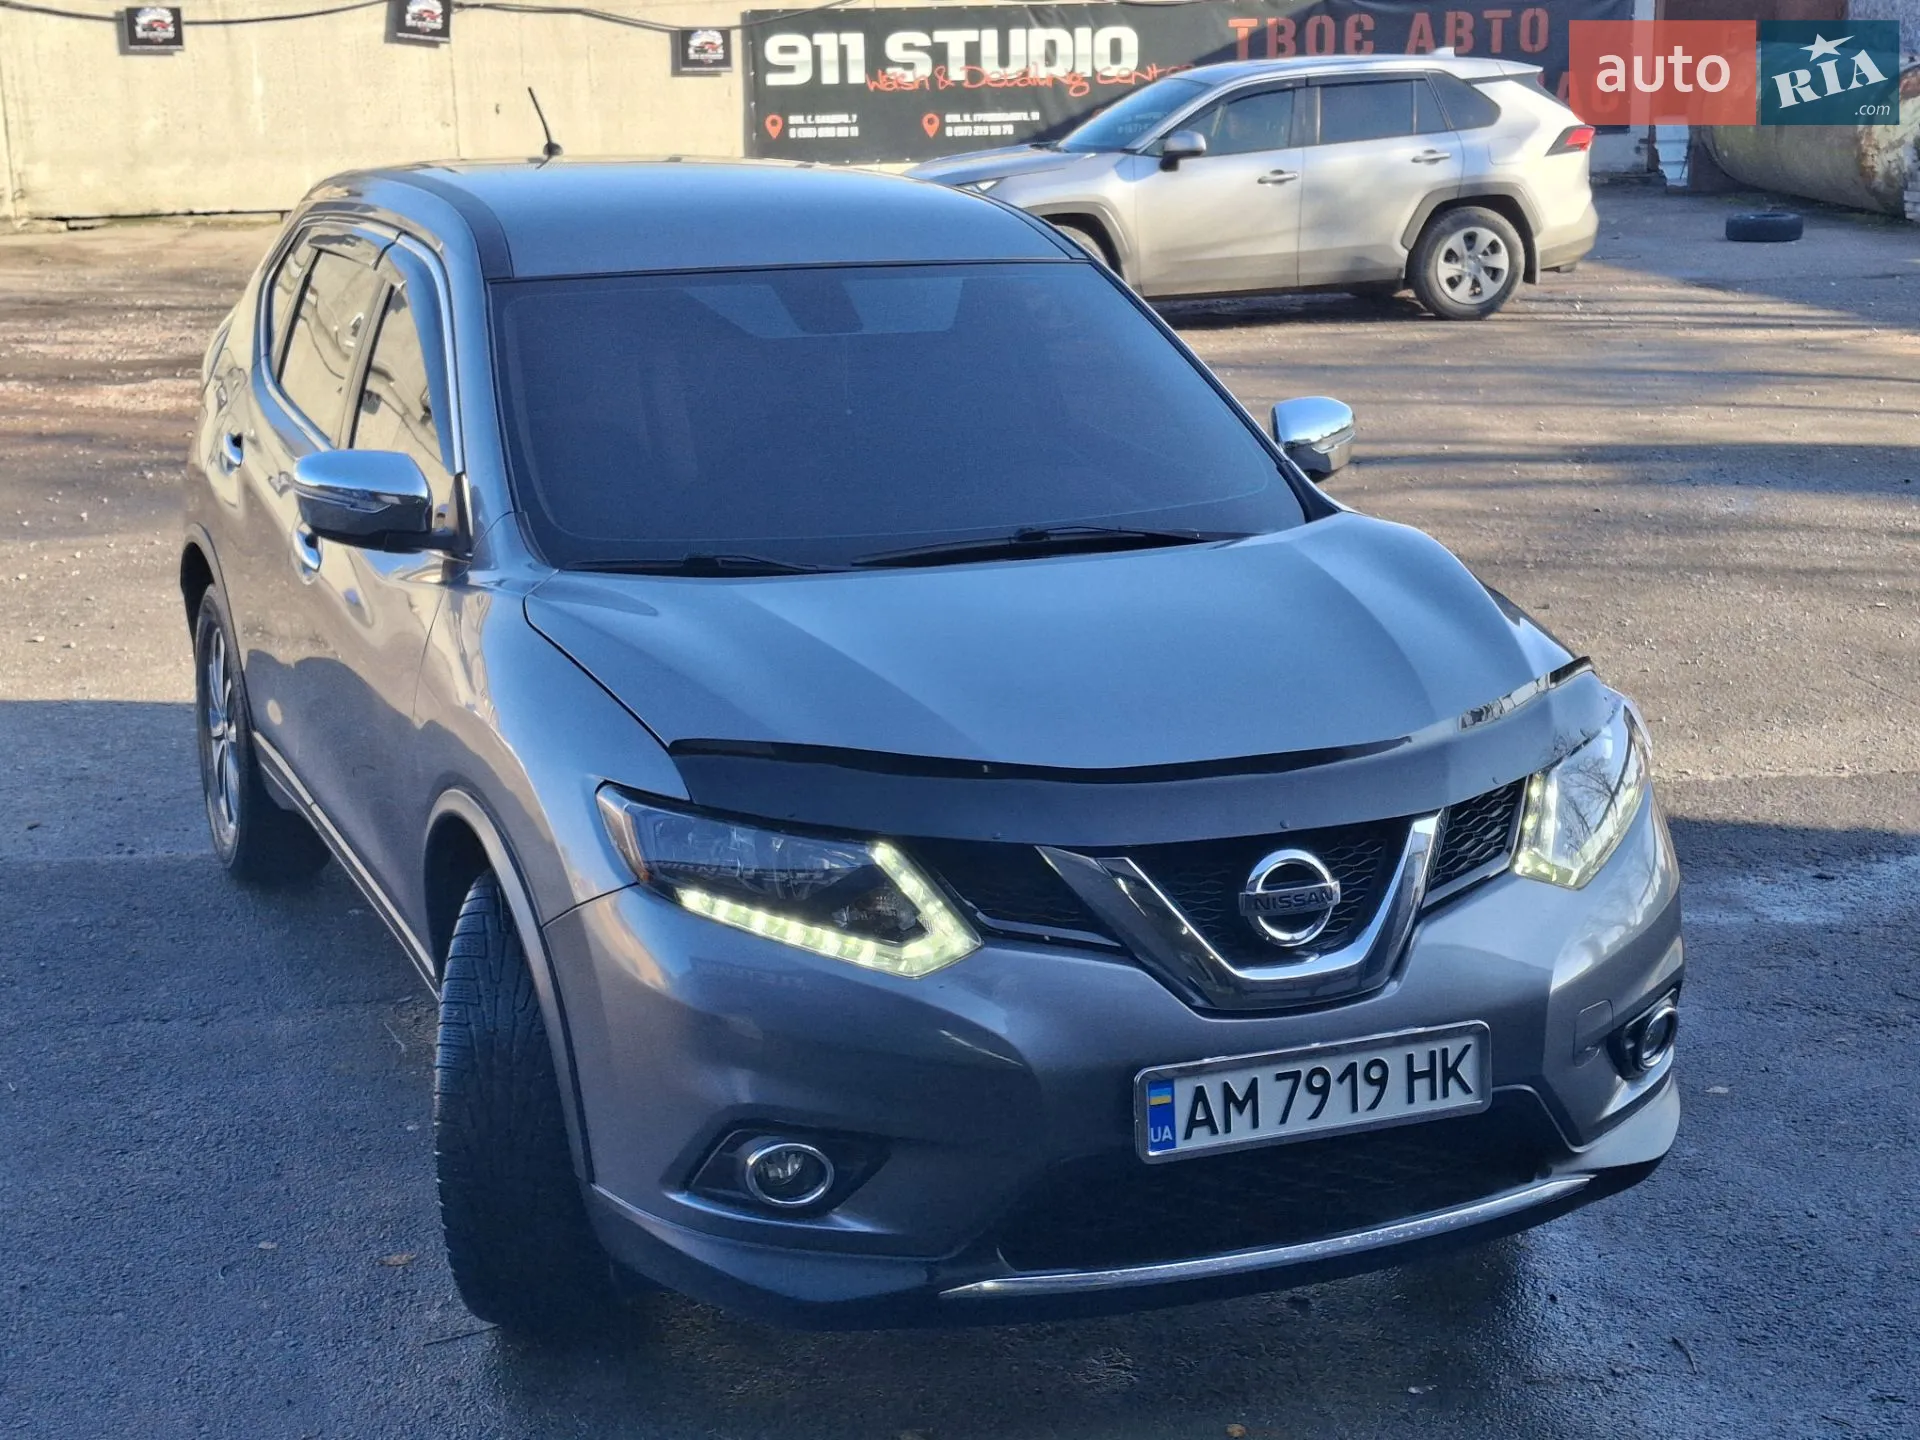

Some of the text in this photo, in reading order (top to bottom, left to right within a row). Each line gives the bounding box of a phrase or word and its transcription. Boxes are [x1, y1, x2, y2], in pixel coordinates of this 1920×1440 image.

[1228, 8, 1549, 60] ТВОЄ АВТО
[764, 26, 1139, 86] 911 STUDIO
[865, 69, 930, 92] Wash
[934, 65, 956, 90] &
[1254, 885, 1335, 911] NISSAN
[1183, 1043, 1474, 1141] AM 7919 HK
[1150, 1127, 1173, 1143] UA
